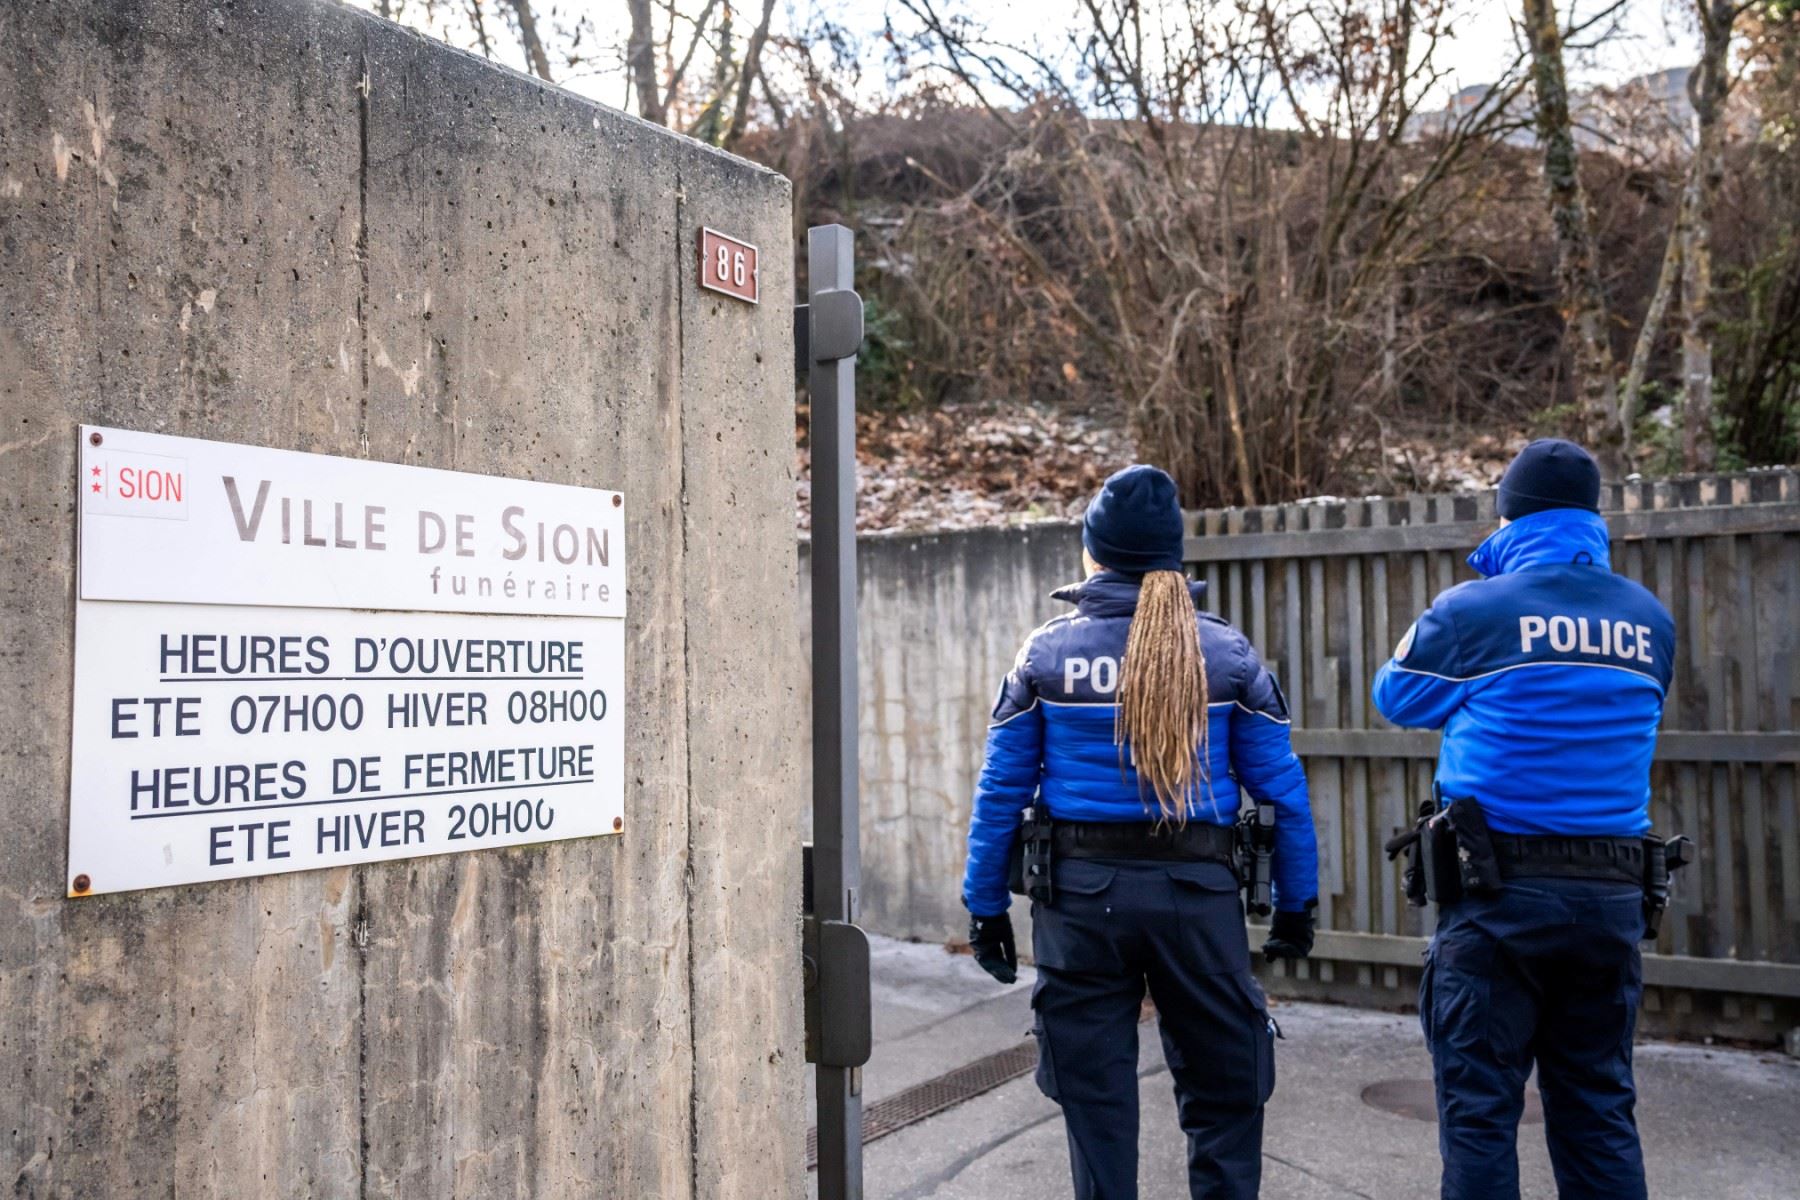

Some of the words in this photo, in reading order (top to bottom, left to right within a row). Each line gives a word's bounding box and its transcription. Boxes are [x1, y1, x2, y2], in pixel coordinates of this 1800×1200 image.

[717, 245, 745, 287] 86
[118, 466, 183, 502] SION
[222, 476, 387, 551] VILLE
[418, 510, 476, 557] DE
[501, 506, 610, 567] SION
[430, 567, 611, 603] funéraire
[160, 634, 330, 674] HEURES
[355, 637, 584, 673] D'OUVERTURE
[1519, 615, 1654, 664] POLICE
[111, 698, 201, 739] ETE
[230, 693, 364, 735] 07H00
[387, 692, 488, 729] HIVER
[507, 689, 608, 724] 08H00
[130, 760, 308, 810] HEURES
[332, 756, 382, 795] DE
[404, 745, 595, 790] FERMETURE
[209, 820, 291, 867] ETE
[316, 810, 425, 855] HIVER
[447, 798, 555, 840] 20H00
